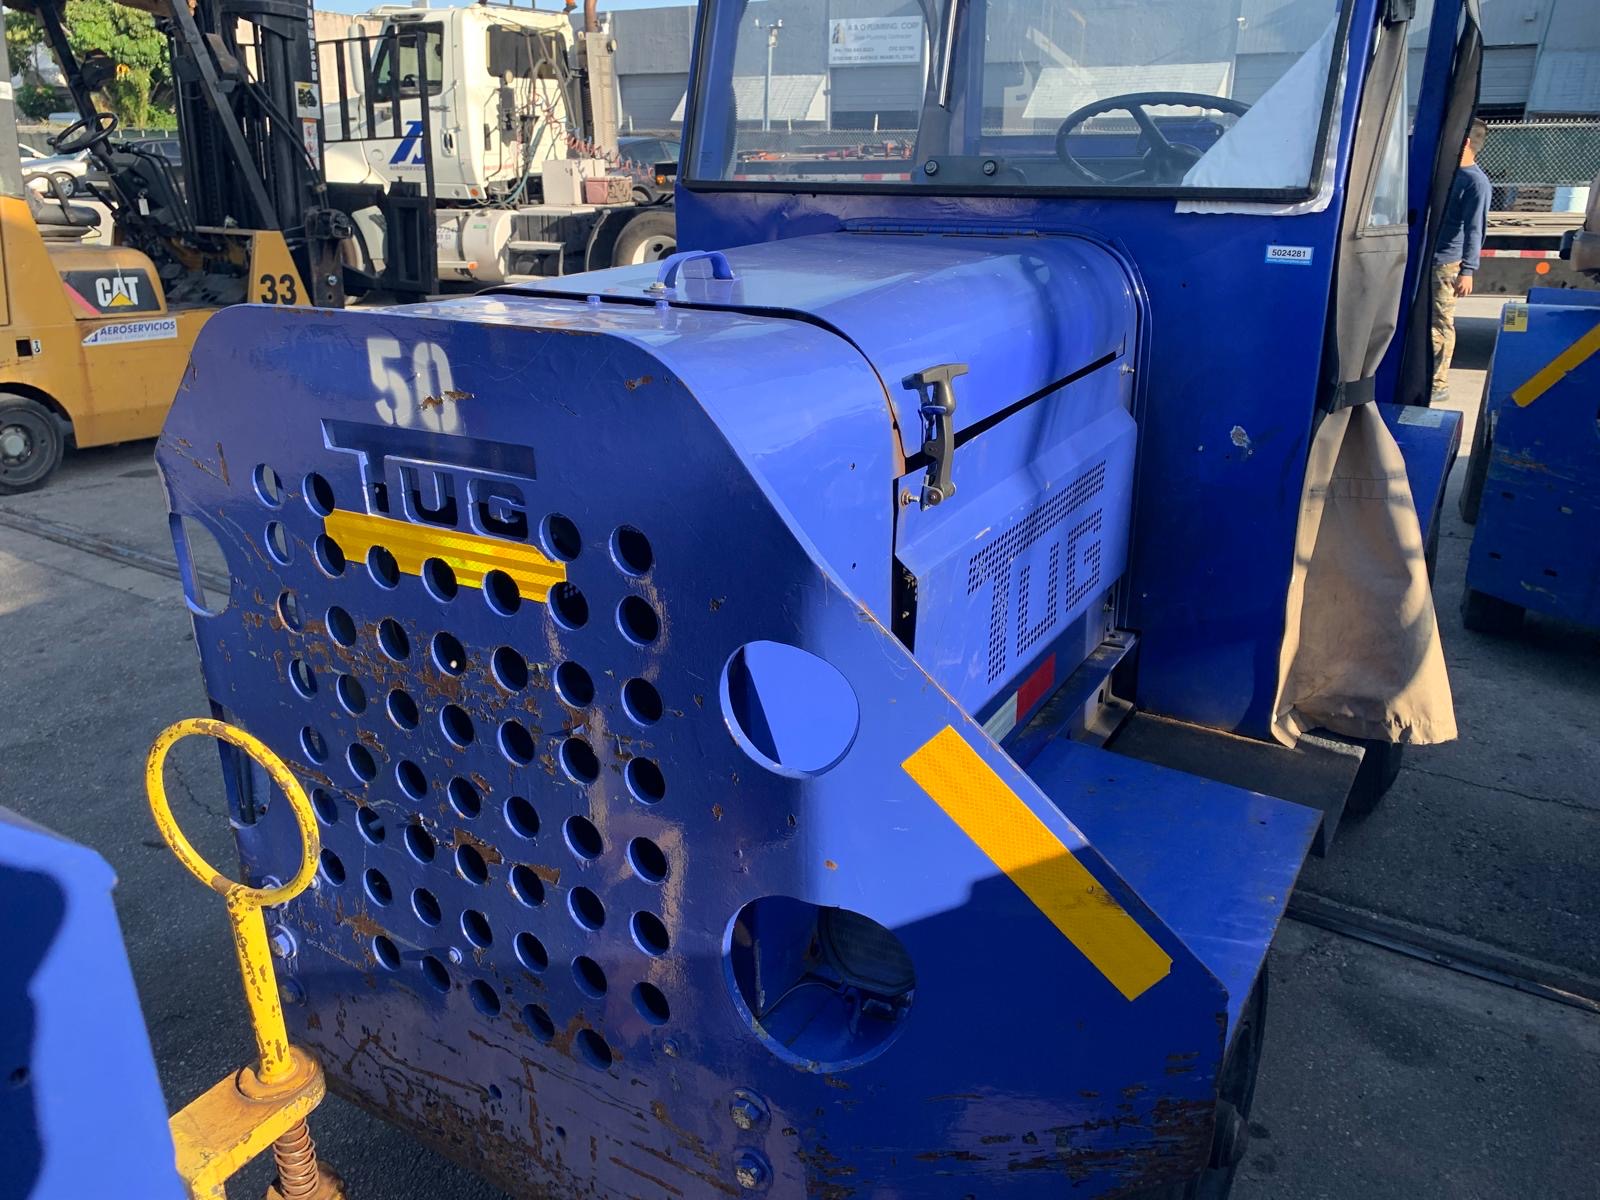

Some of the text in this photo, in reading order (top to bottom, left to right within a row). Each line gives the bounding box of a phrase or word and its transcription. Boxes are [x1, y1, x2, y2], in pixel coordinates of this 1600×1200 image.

[1271, 249, 1306, 257] 5024281
[95, 276, 138, 307] CAT
[260, 274, 297, 305] 33
[100, 321, 175, 335] AEROSERVICIOS
[366, 337, 458, 433] 50
[320, 418, 538, 543] TUG
[967, 459, 1107, 685] TUG
